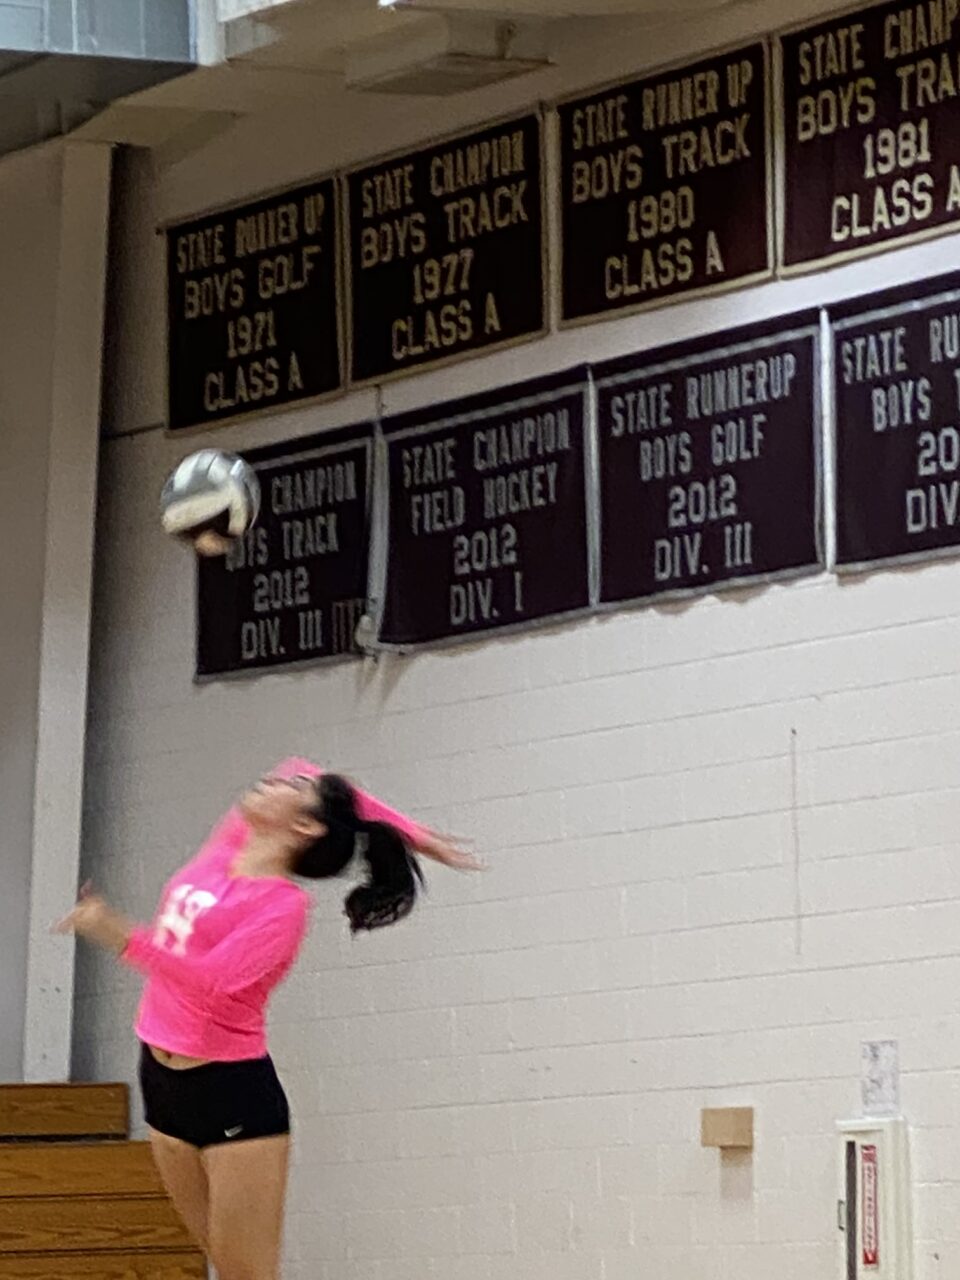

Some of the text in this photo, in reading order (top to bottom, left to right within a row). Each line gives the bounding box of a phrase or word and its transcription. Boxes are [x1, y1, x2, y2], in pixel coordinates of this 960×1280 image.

[798, 24, 866, 86] STATE
[572, 60, 753, 150] STATE RUNNER UP
[797, 52, 960, 141] BOYS TRA
[362, 130, 526, 218] STATE CHAMPION
[572, 113, 751, 203] BOYS TRACK
[863, 117, 931, 179] 1981
[177, 193, 325, 273] STATE RUNNER UP
[361, 180, 529, 269] BOYS TRACK
[627, 185, 695, 242] 1980
[831, 165, 960, 242] CLASS A
[185, 245, 321, 319] BOYS GOLF
[413, 248, 474, 304] 1977
[605, 230, 724, 300] CLASS A
[228, 308, 277, 358] 1971
[392, 292, 501, 360] CLASS A
[842, 326, 907, 384] STATE
[204, 351, 304, 412] CLASS A
[610, 353, 796, 437] STATE RUNNERUP
[872, 377, 932, 432] BOYS
[402, 408, 570, 488] STATE CHAMPION
[640, 414, 766, 482] BOYS GOLF
[271, 460, 357, 515] CHAMPION
[411, 462, 558, 535] FIELD HOCKEY
[668, 473, 737, 528] 2012
[282, 512, 339, 560] TRACK
[453, 523, 517, 576] 2012
[654, 522, 753, 581] DIV. III
[253, 566, 310, 612] 2012
[450, 571, 524, 625] DIV. I
[241, 616, 286, 660] DIV.
